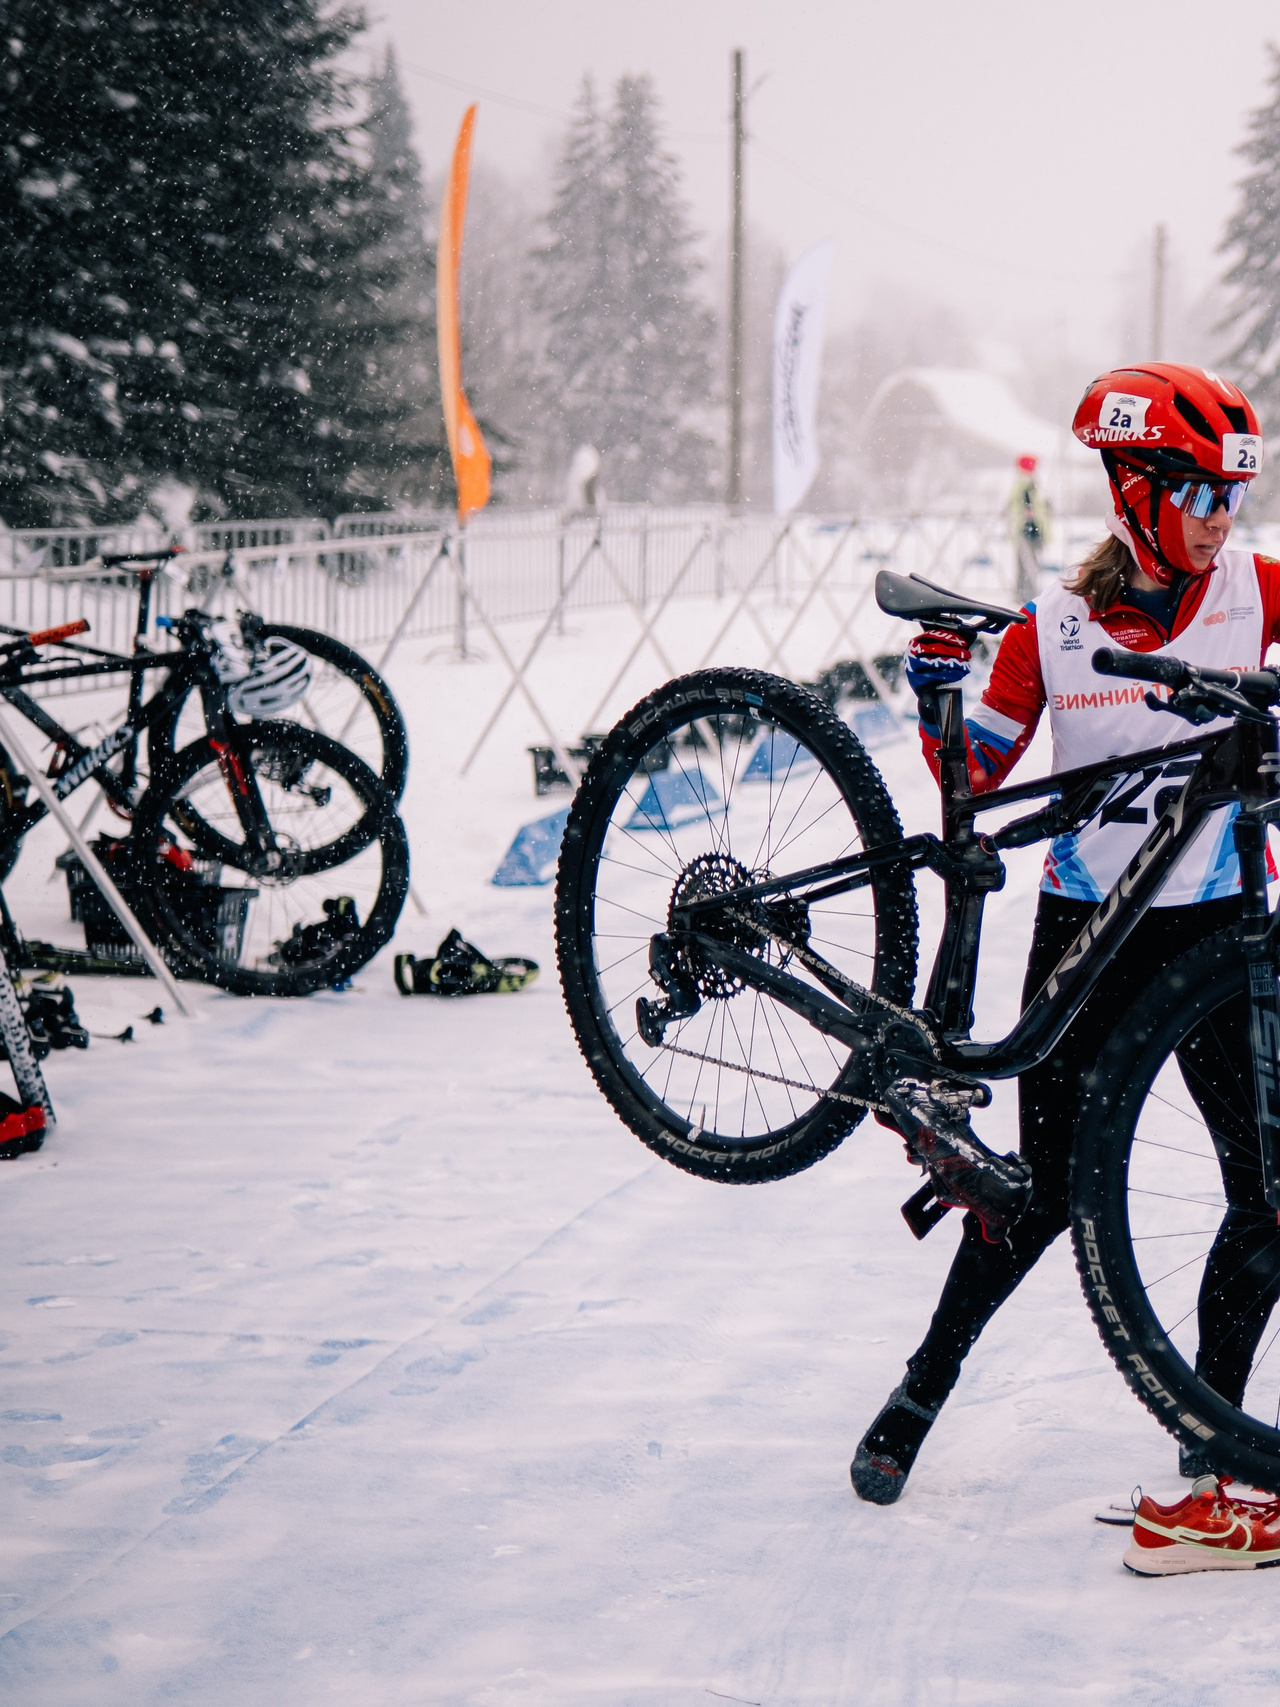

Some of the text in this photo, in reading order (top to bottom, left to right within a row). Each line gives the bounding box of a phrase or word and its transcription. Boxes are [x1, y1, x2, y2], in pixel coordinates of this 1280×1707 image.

[1109, 407, 1132, 429] 2a
[1082, 425, 1165, 442] S-WORKS
[1237, 449, 1257, 469] 2a
[1059, 643, 1084, 652] Triathlon
[1052, 682, 1146, 711] ЗИМНИЙ
[627, 687, 744, 738] SCHWALBE
[657, 1129, 791, 1164] ROCKET RON
[1080, 1217, 1178, 1409] ROCKET RON
